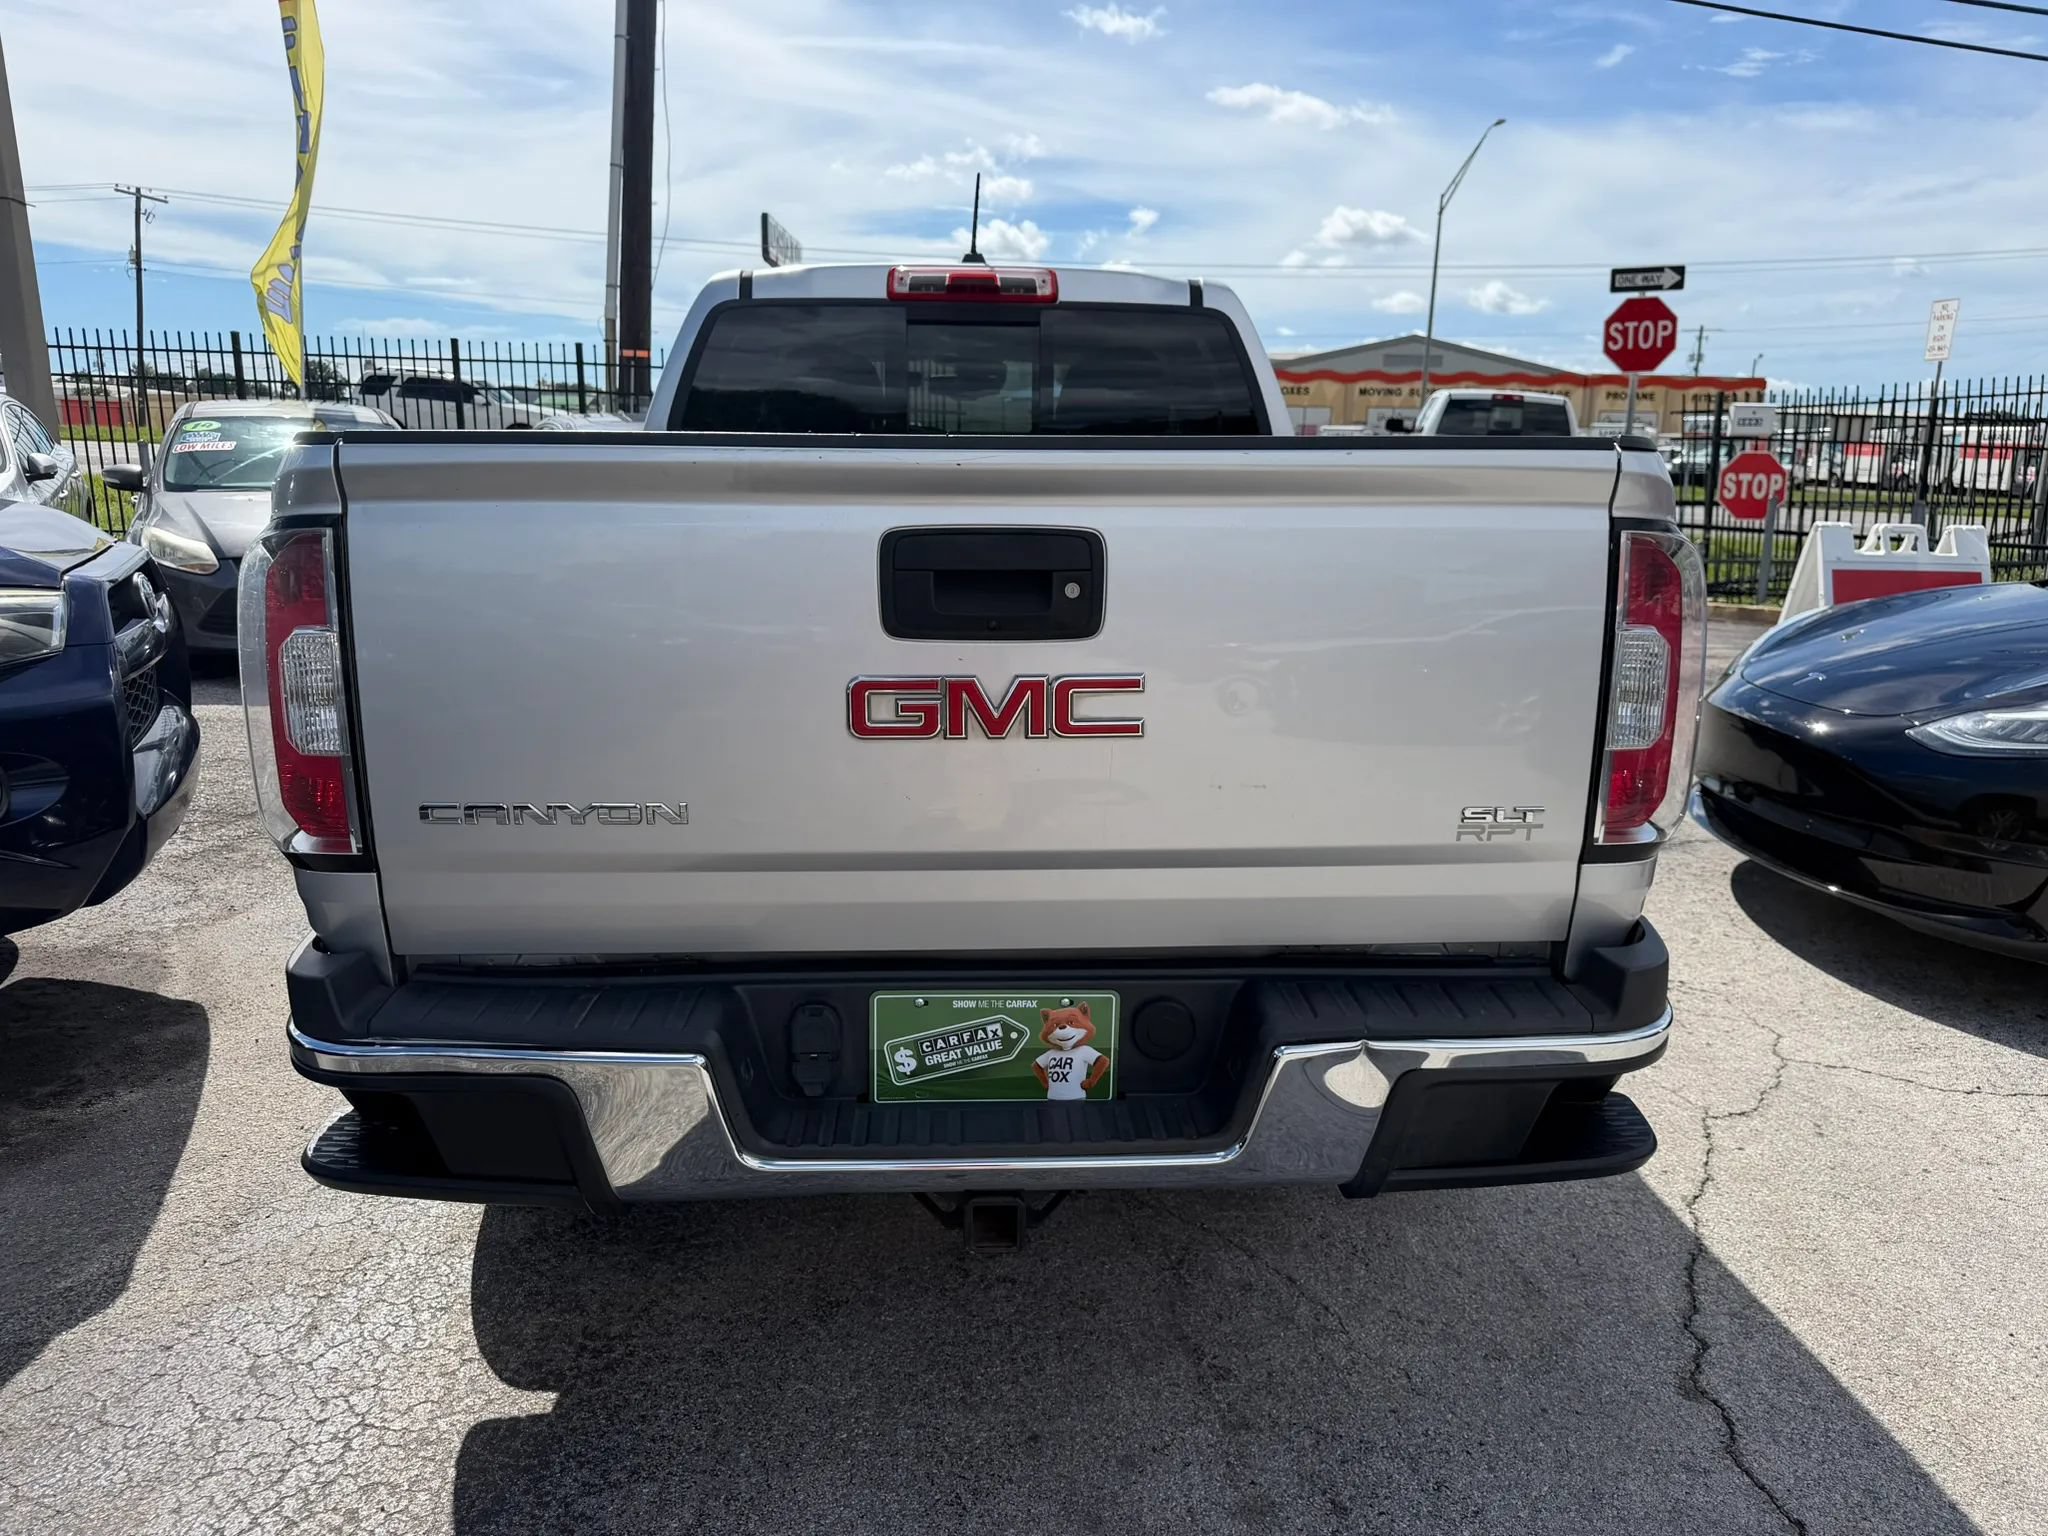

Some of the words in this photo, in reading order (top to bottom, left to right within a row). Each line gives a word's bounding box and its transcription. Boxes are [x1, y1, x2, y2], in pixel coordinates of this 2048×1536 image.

[1617, 274, 1636, 287] ONE
[1641, 272, 1663, 285] WAY
[1607, 320, 1674, 351] STOP
[1281, 386, 1310, 396] OXES
[1359, 387, 1402, 397] MOVING
[1606, 390, 1656, 401] PROANE
[175, 443, 198, 451] LOW
[199, 442, 233, 450] MILES
[1722, 472, 1783, 500] STOP
[846, 672, 1145, 740] GMC
[418, 802, 688, 825] CANYON
[1460, 806, 1545, 823] SLT
[1455, 823, 1544, 842] RPT
[952, 1000, 977, 1008] SHOW
[977, 1000, 990, 1008] ME
[990, 1000, 1005, 1008] THE
[1005, 1000, 1038, 1008] CARFAX
[920, 1026, 1001, 1053] CARFAX
[893, 1046, 917, 1075] $
[925, 1048, 962, 1066] GREAT
[964, 1039, 1003, 1056] VALUE
[943, 1061, 957, 1069] SHOW
[971, 1054, 989, 1062] CARFAX
[1049, 1057, 1073, 1070] CAR
